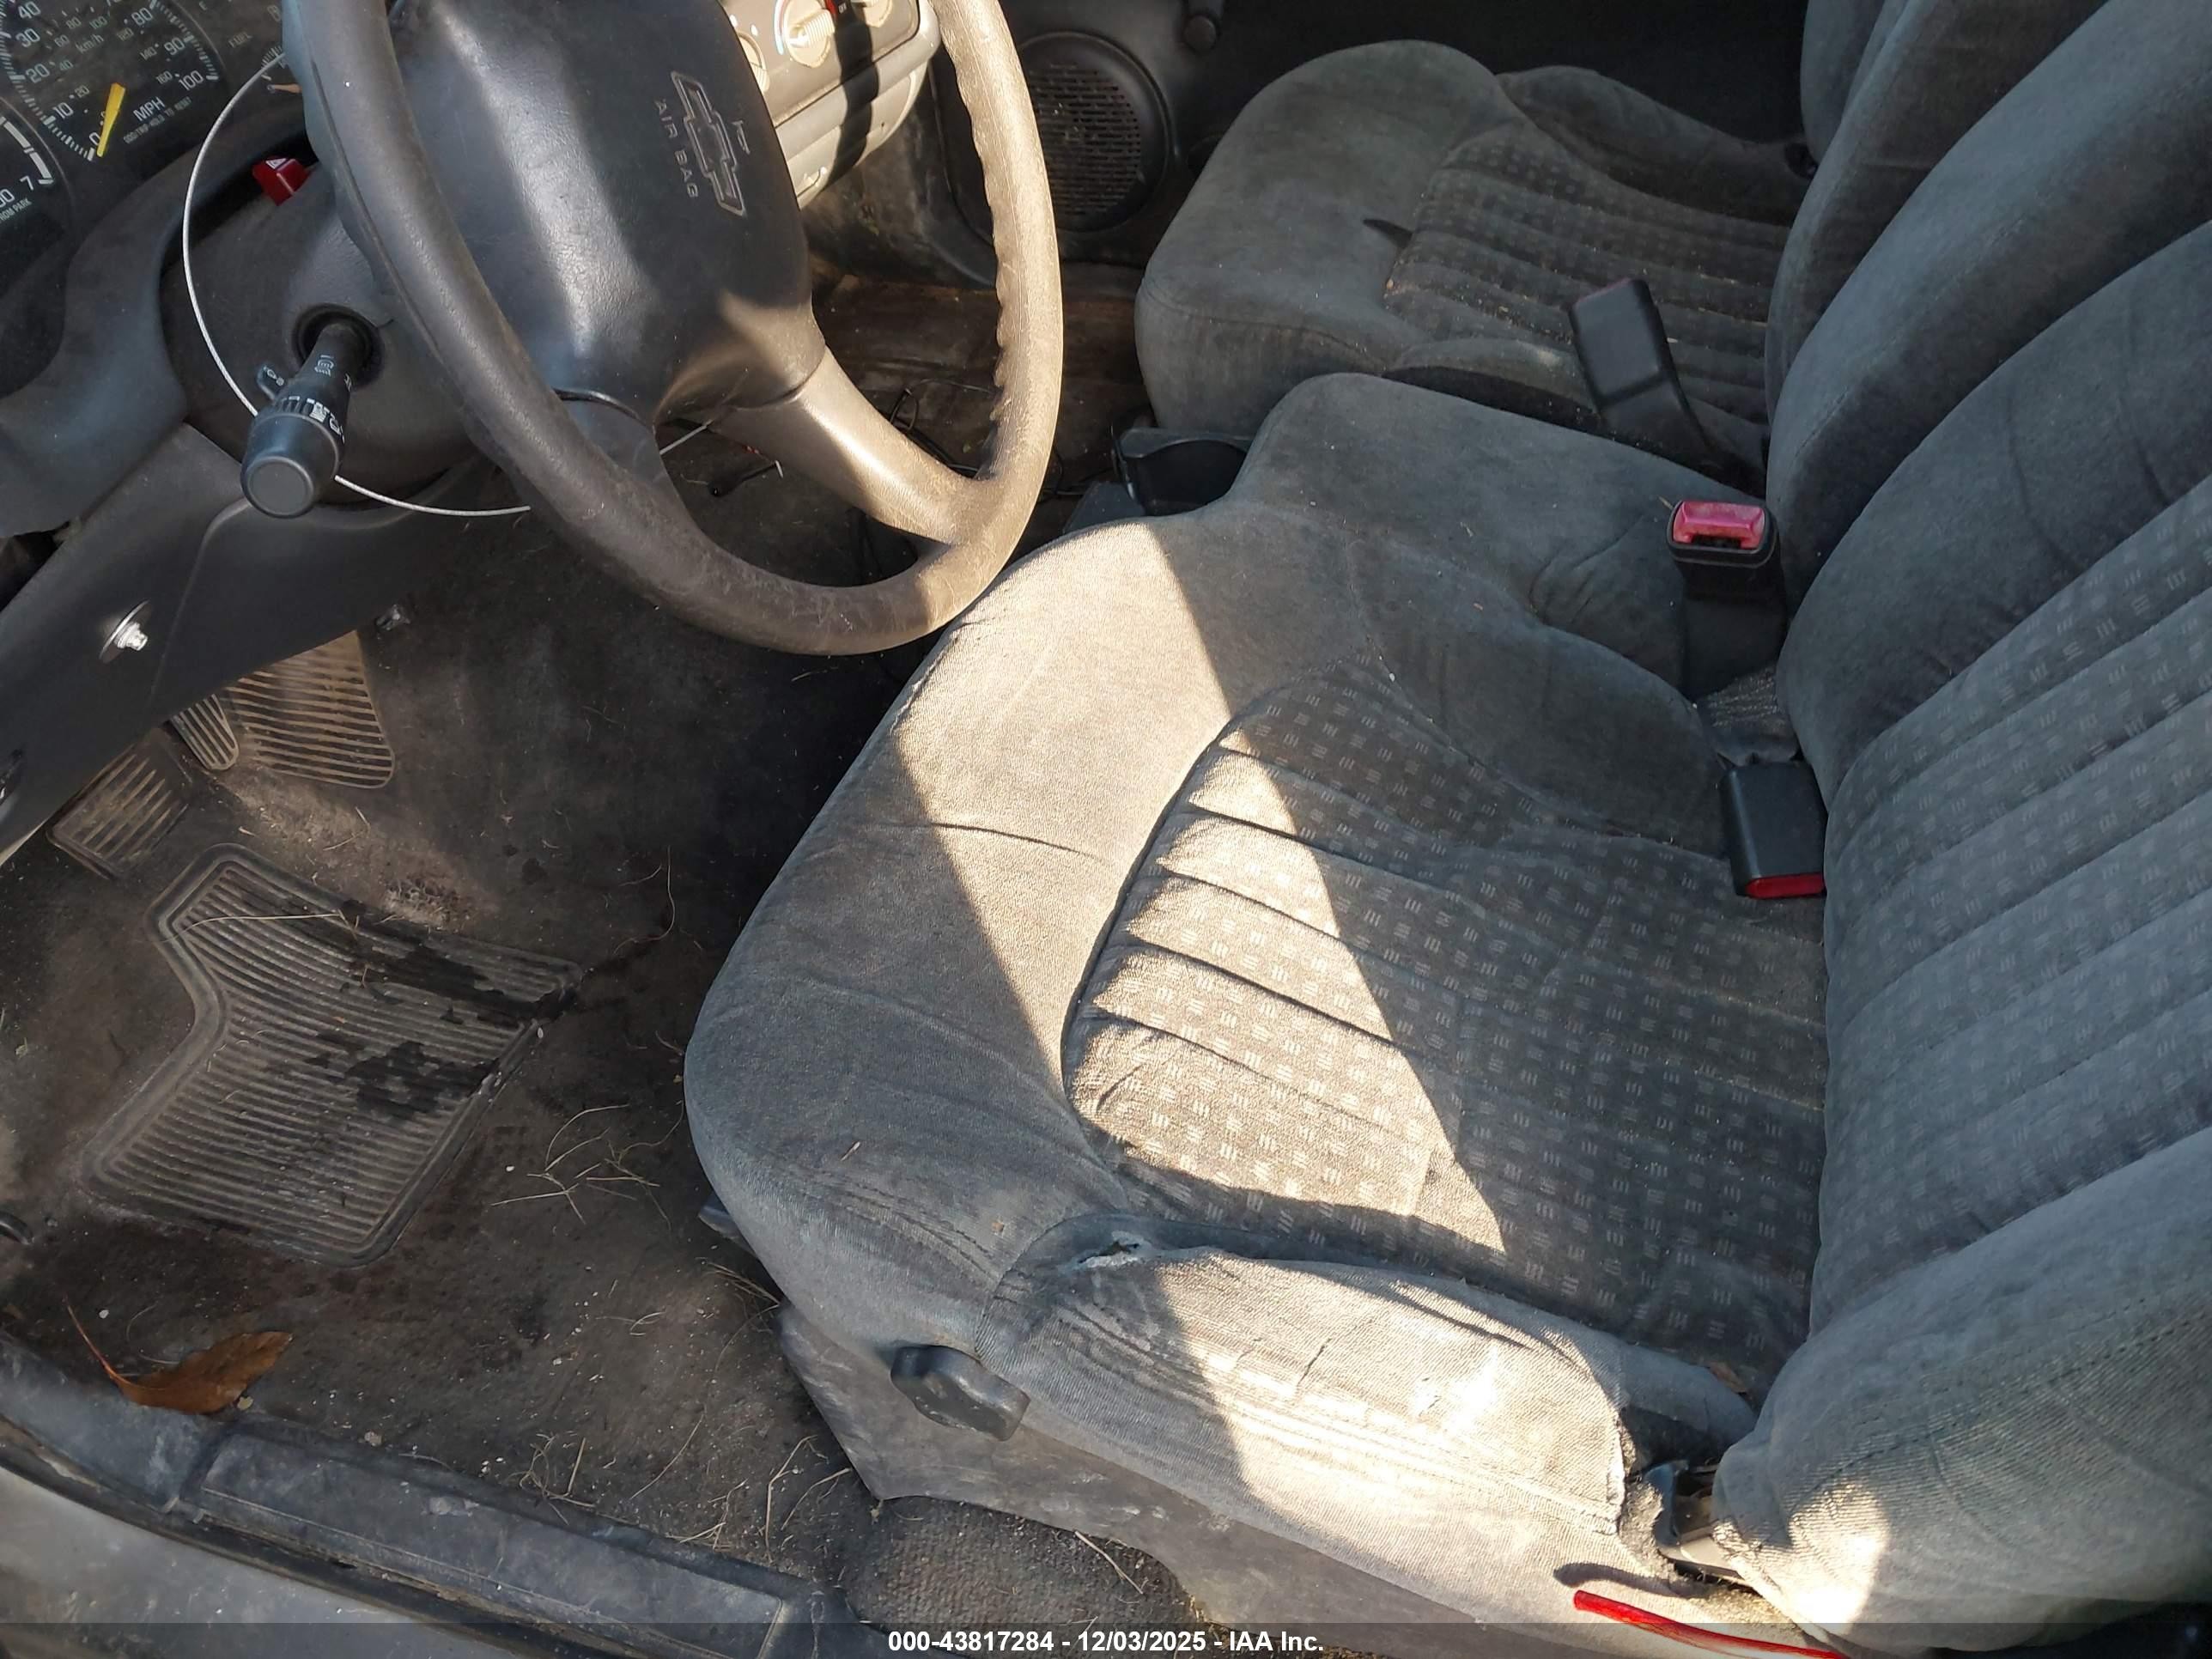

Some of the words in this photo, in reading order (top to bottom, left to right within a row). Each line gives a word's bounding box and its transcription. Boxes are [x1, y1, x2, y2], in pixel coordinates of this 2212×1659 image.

[18, 1, 41, 19] 40
[131, 8, 153, 26] 80
[89, 16, 108, 29] 100
[15, 28, 41, 48] 30
[54, 35, 70, 47] 60
[75, 34, 105, 53] km/h
[163, 37, 185, 56] 90
[228, 33, 252, 48] FUEL
[25, 64, 51, 83] 20
[59, 60, 74, 70] 40
[178, 70, 205, 91] 100
[74, 85, 90, 98] 20
[52, 102, 75, 119] 10
[132, 96, 166, 121] MPH
[652, 98, 679, 139] AIR
[673, 149, 700, 198] BAG
[19, 175, 34, 191] 7
[13, 198, 33, 213] PARK
